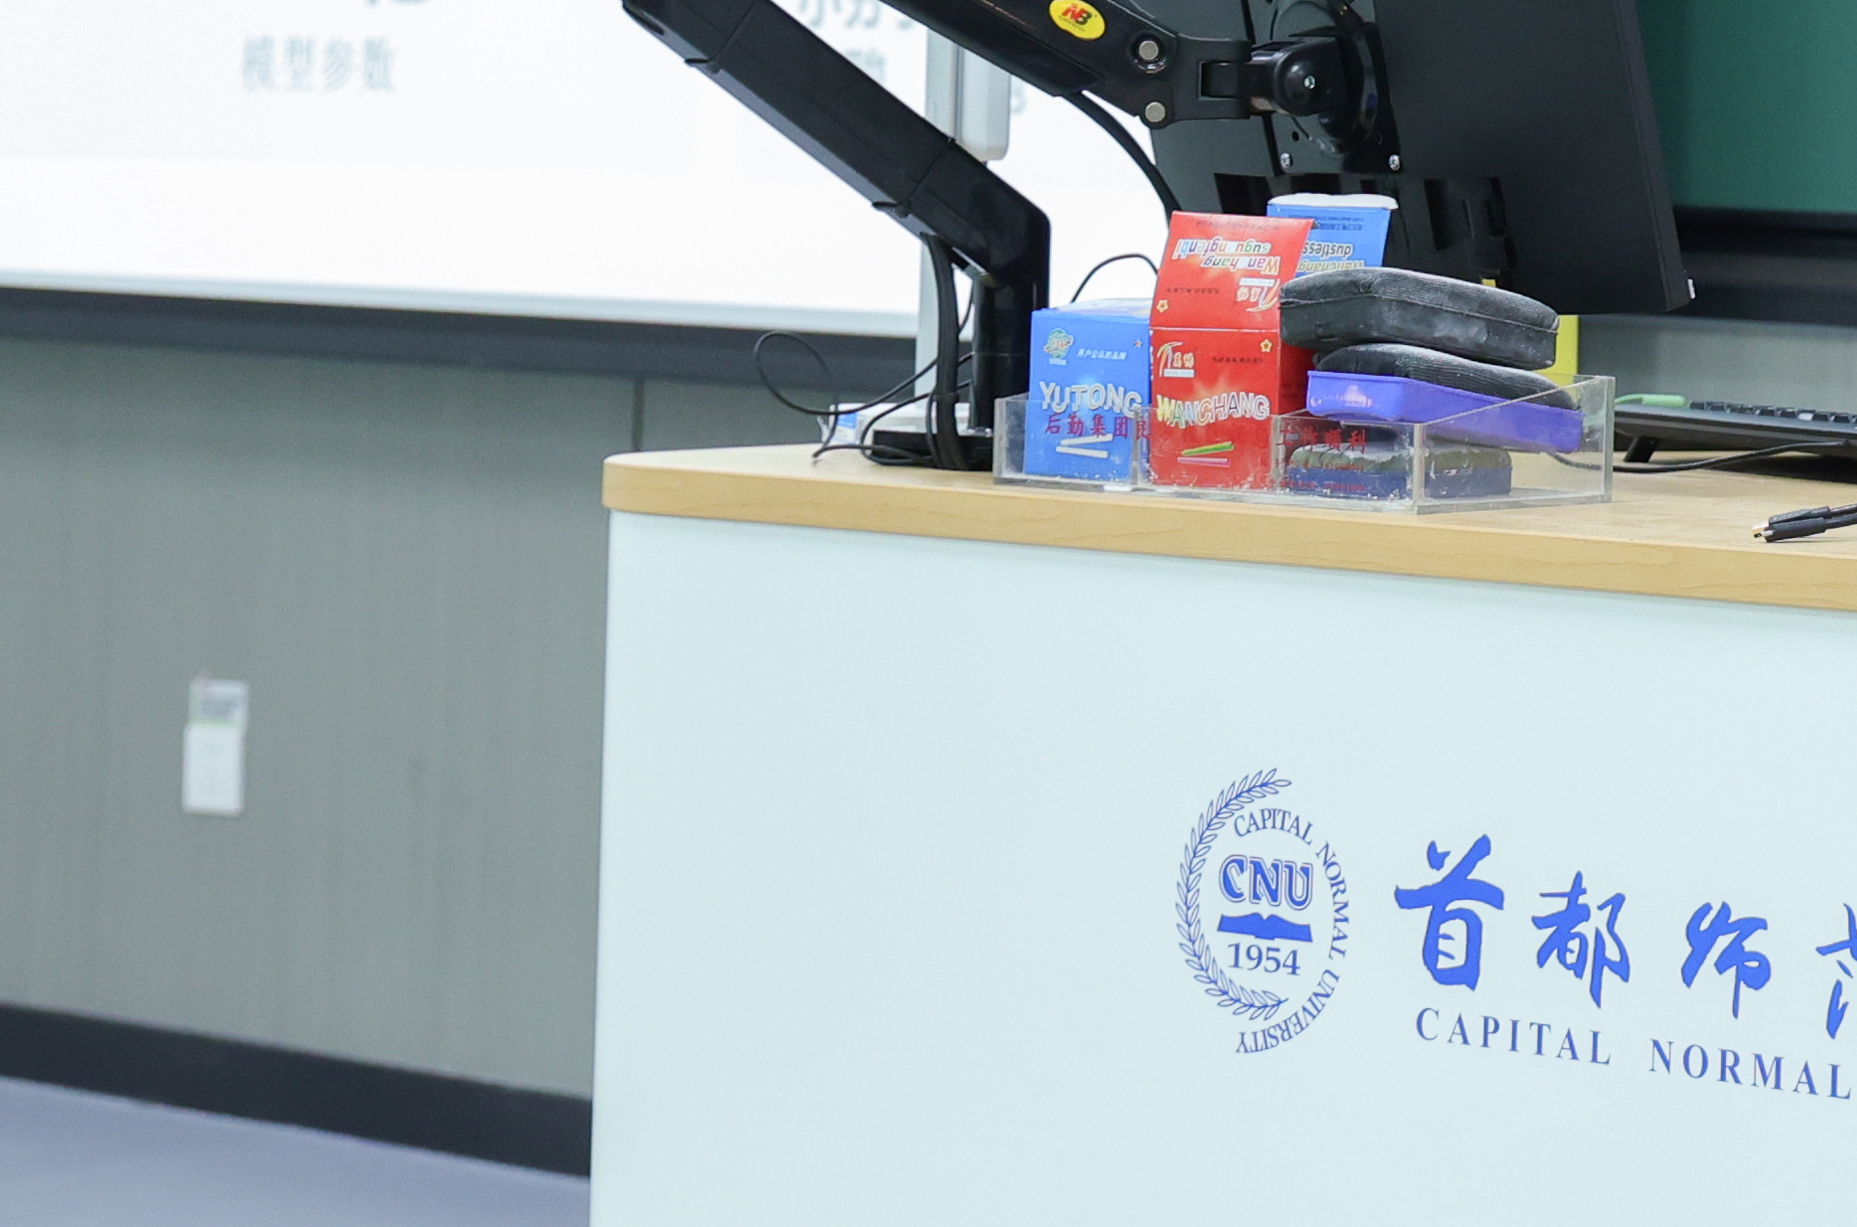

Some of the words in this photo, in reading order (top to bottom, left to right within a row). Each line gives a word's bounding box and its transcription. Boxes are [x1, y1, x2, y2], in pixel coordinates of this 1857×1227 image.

[1200, 251, 1281, 275] Wanchang
[1039, 381, 1142, 419] YUTONG
[1156, 392, 1270, 430] WANCHANG
[1233, 807, 1314, 846] CAPITAL
[1218, 854, 1314, 911] CNU
[1316, 841, 1350, 960] NORMAL
[1227, 942, 1302, 976] 1954
[1235, 969, 1340, 1054] UNIVERSITY
[1415, 1006, 1612, 1066] CAPITAL
[1647, 1038, 1853, 1101] NORMAL
